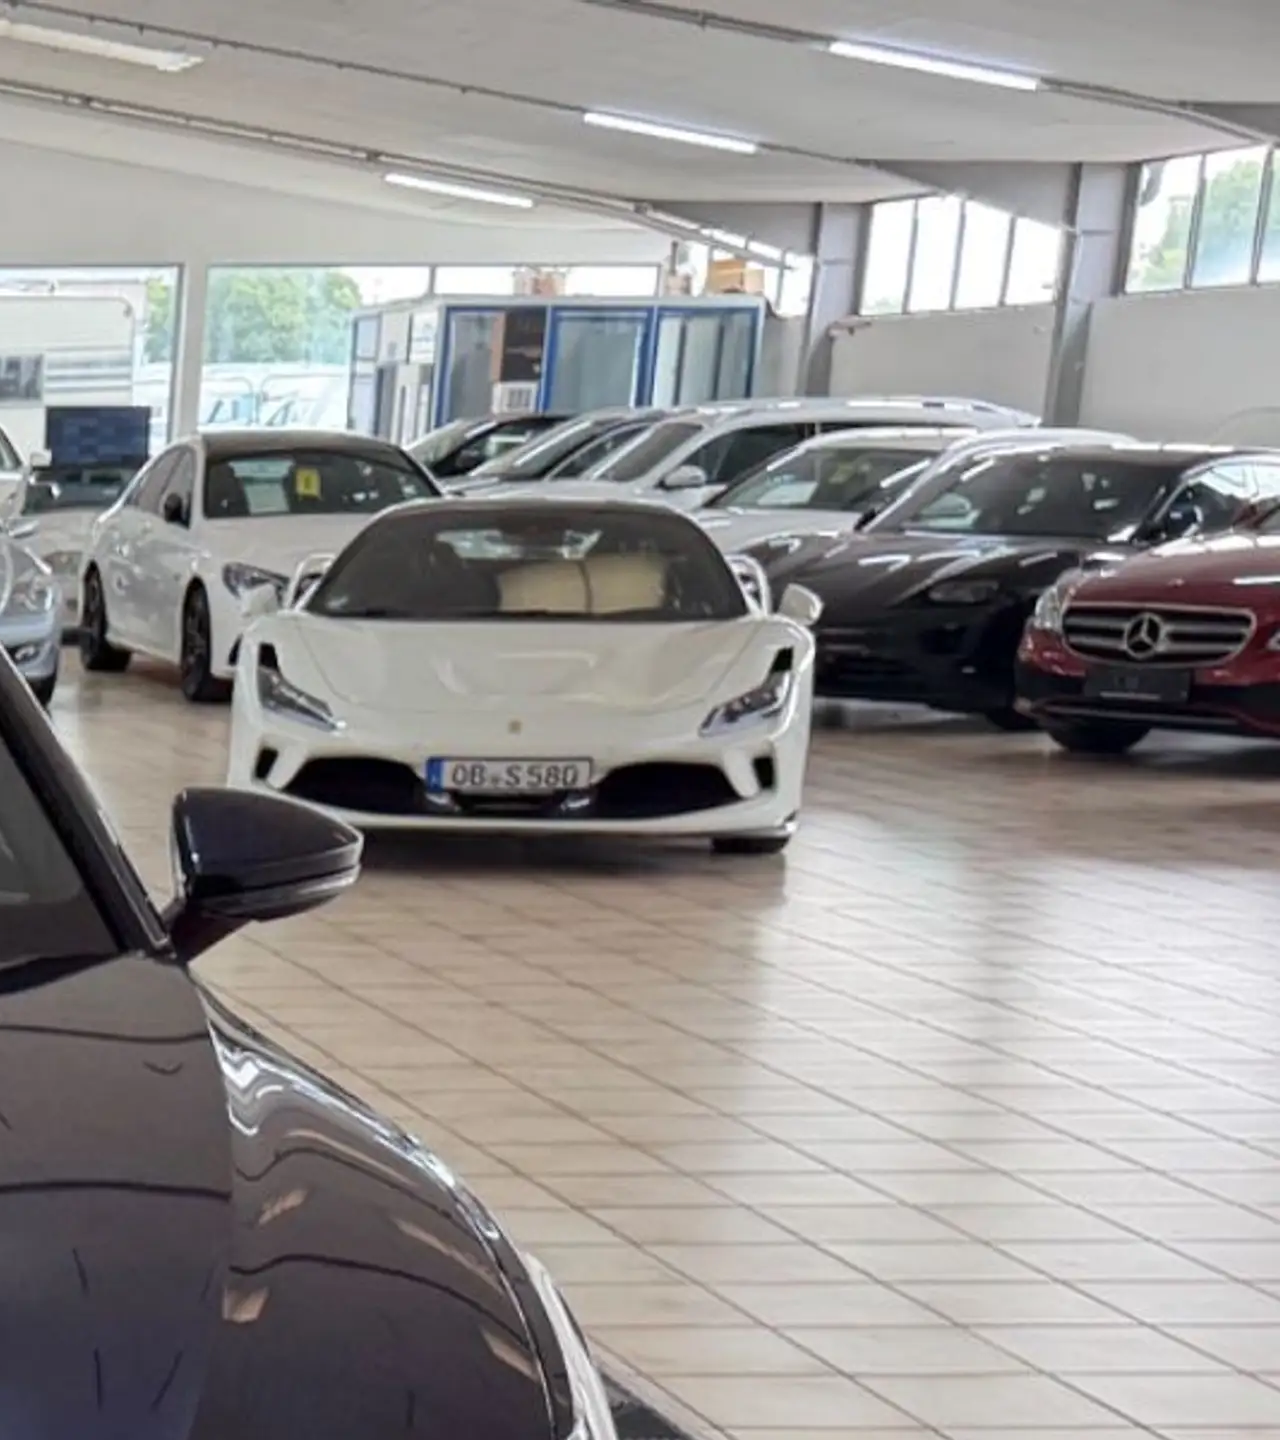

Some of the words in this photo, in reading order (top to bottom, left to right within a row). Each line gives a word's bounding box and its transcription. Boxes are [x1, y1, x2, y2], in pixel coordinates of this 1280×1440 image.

[452, 763, 487, 786] OB
[505, 764, 521, 787] S
[526, 763, 578, 787] 580
